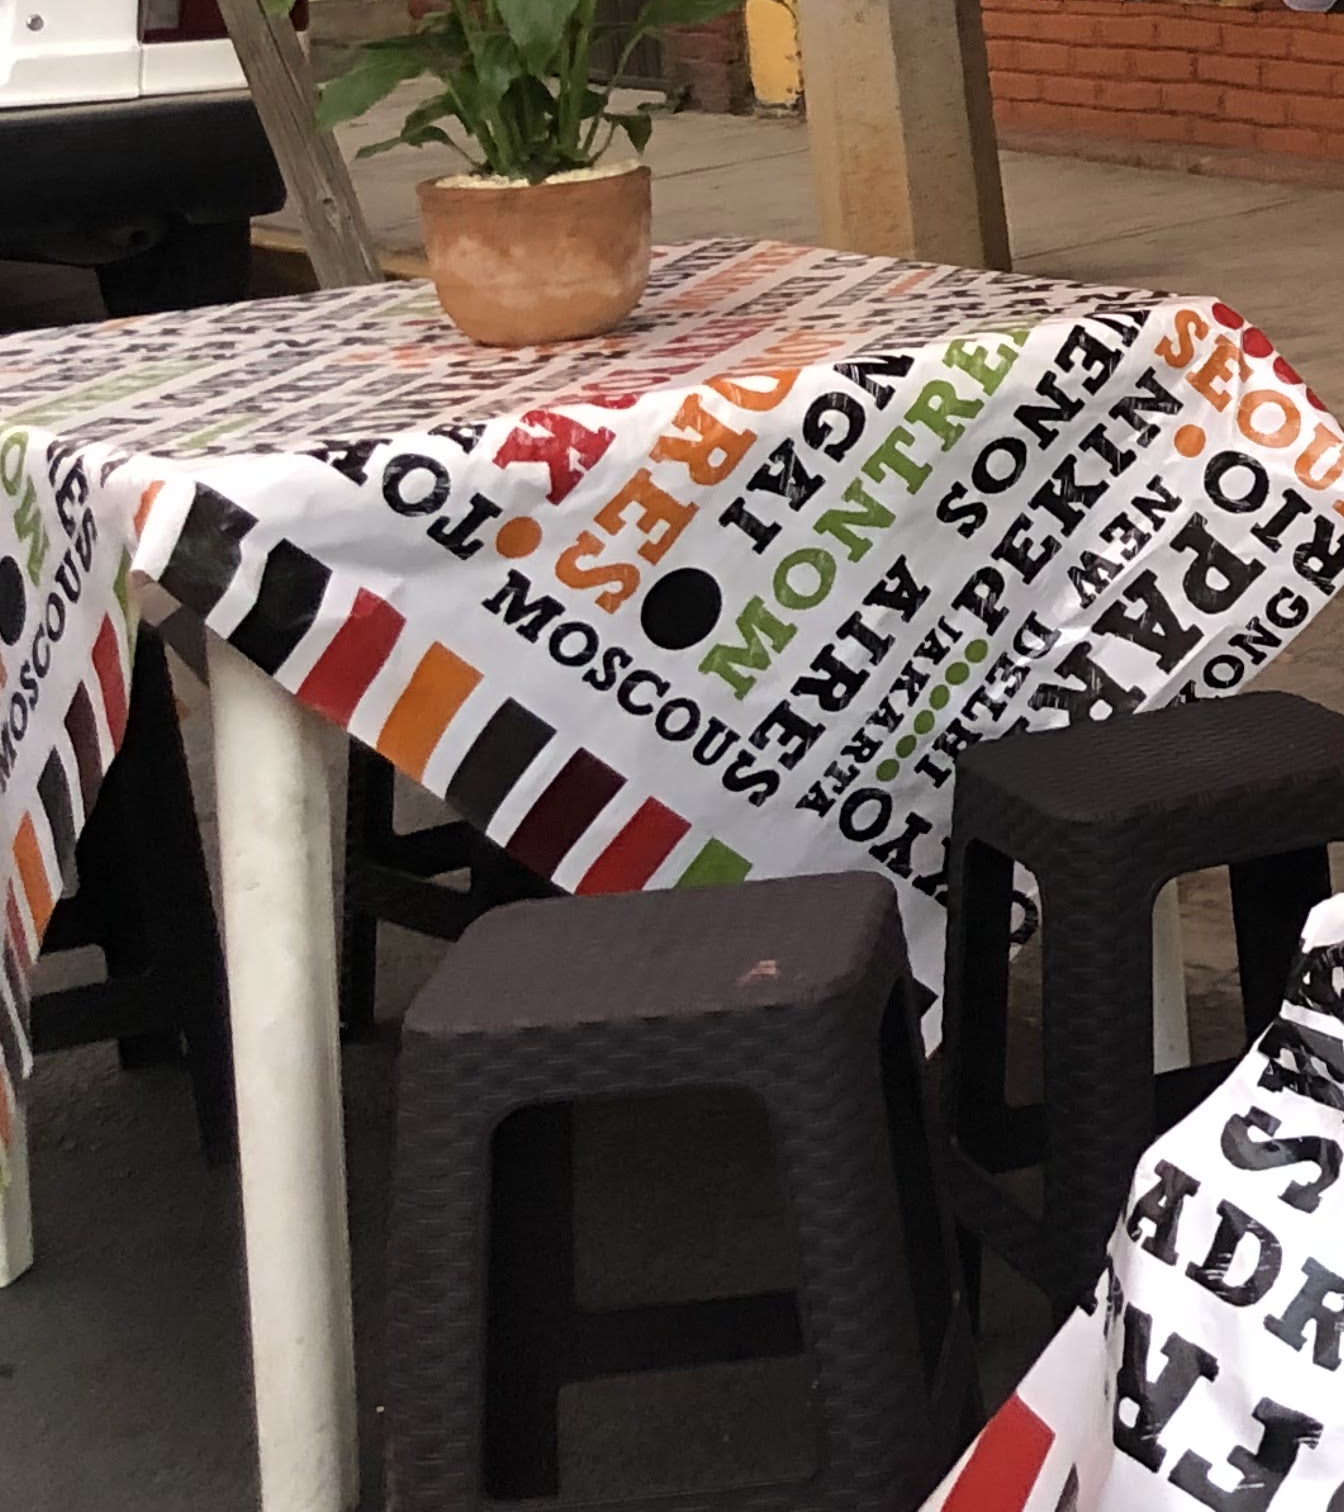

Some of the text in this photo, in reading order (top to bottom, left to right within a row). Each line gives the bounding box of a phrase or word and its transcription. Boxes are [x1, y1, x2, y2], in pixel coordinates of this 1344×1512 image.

[914, 475, 1184, 789] NEW DELHI
[951, 367, 1186, 636] PEKIN
[796, 613, 964, 818] JAKARTA
